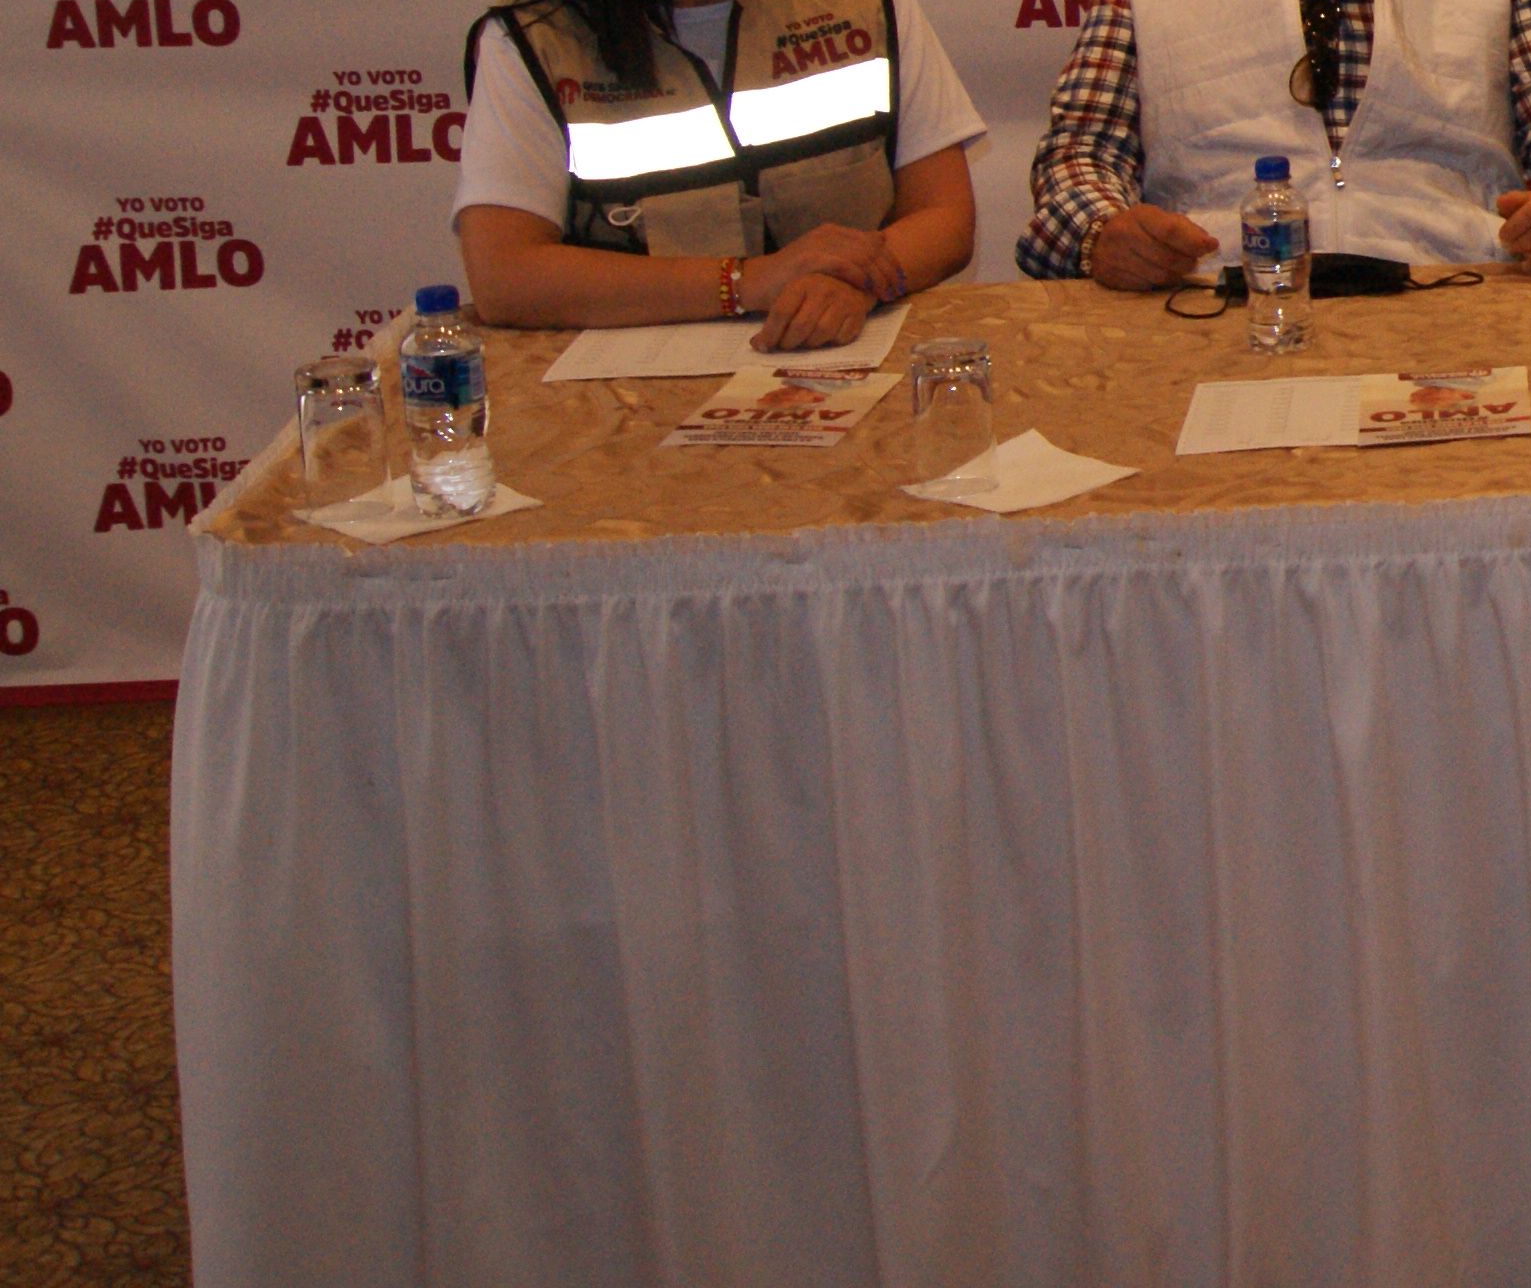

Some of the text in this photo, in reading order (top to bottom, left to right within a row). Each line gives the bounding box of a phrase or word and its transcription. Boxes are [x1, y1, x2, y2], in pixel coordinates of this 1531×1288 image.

[776, 19, 852, 49] #QueSiga
[786, 12, 834, 32] YO VOTO
[771, 28, 873, 80] AMLO
[116, 197, 205, 213] YO VOTO
[92, 211, 234, 241] #QueSiga
[69, 237, 265, 295] AMLO
